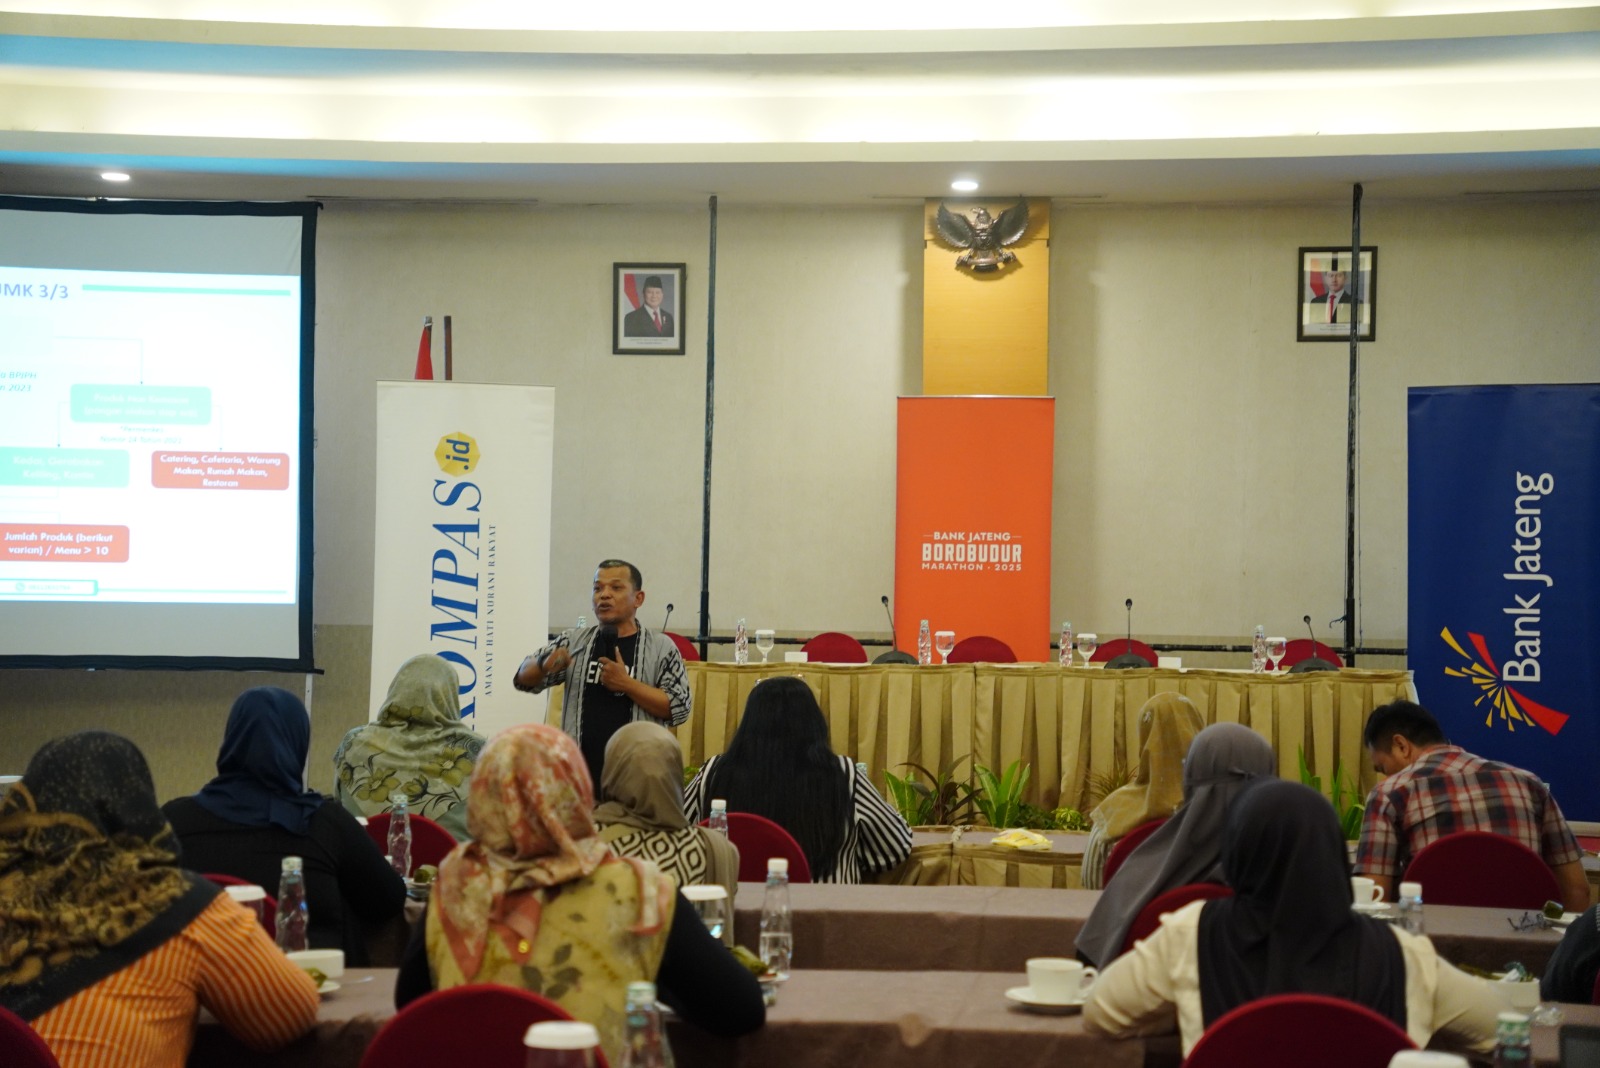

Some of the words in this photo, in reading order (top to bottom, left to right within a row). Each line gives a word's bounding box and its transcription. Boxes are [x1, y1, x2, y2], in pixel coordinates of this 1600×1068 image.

[0, 283, 33, 297] MK
[39, 283, 69, 301] 3/3
[160, 454, 199, 465] Catering,
[247, 456, 281, 467] Warung
[173, 467, 205, 476] Makan,
[207, 467, 235, 476] Rumah
[236, 468, 268, 477] Makan,
[202, 478, 239, 487] Restoran
[5, 532, 37, 541] Jumlah
[40, 532, 73, 541] Produk
[76, 533, 113, 543] (berikut
[933, 531, 966, 541] BANK
[967, 532, 1011, 543] JATENG
[1503, 471, 1555, 587] Jateng
[8, 546, 43, 556] varian)
[55, 546, 81, 555] Menu
[96, 546, 109, 555] 10
[488, 524, 496, 567] RAKYAT
[922, 543, 1022, 563] BOROBUDUR
[921, 562, 984, 571] MARATHON
[994, 563, 1022, 571] 2025
[487, 572, 495, 616] NURANI
[430, 478, 482, 733] OMPAS
[486, 620, 494, 646] HATI
[1503, 592, 1541, 682] Bank
[484, 651, 493, 696] AMANAT
